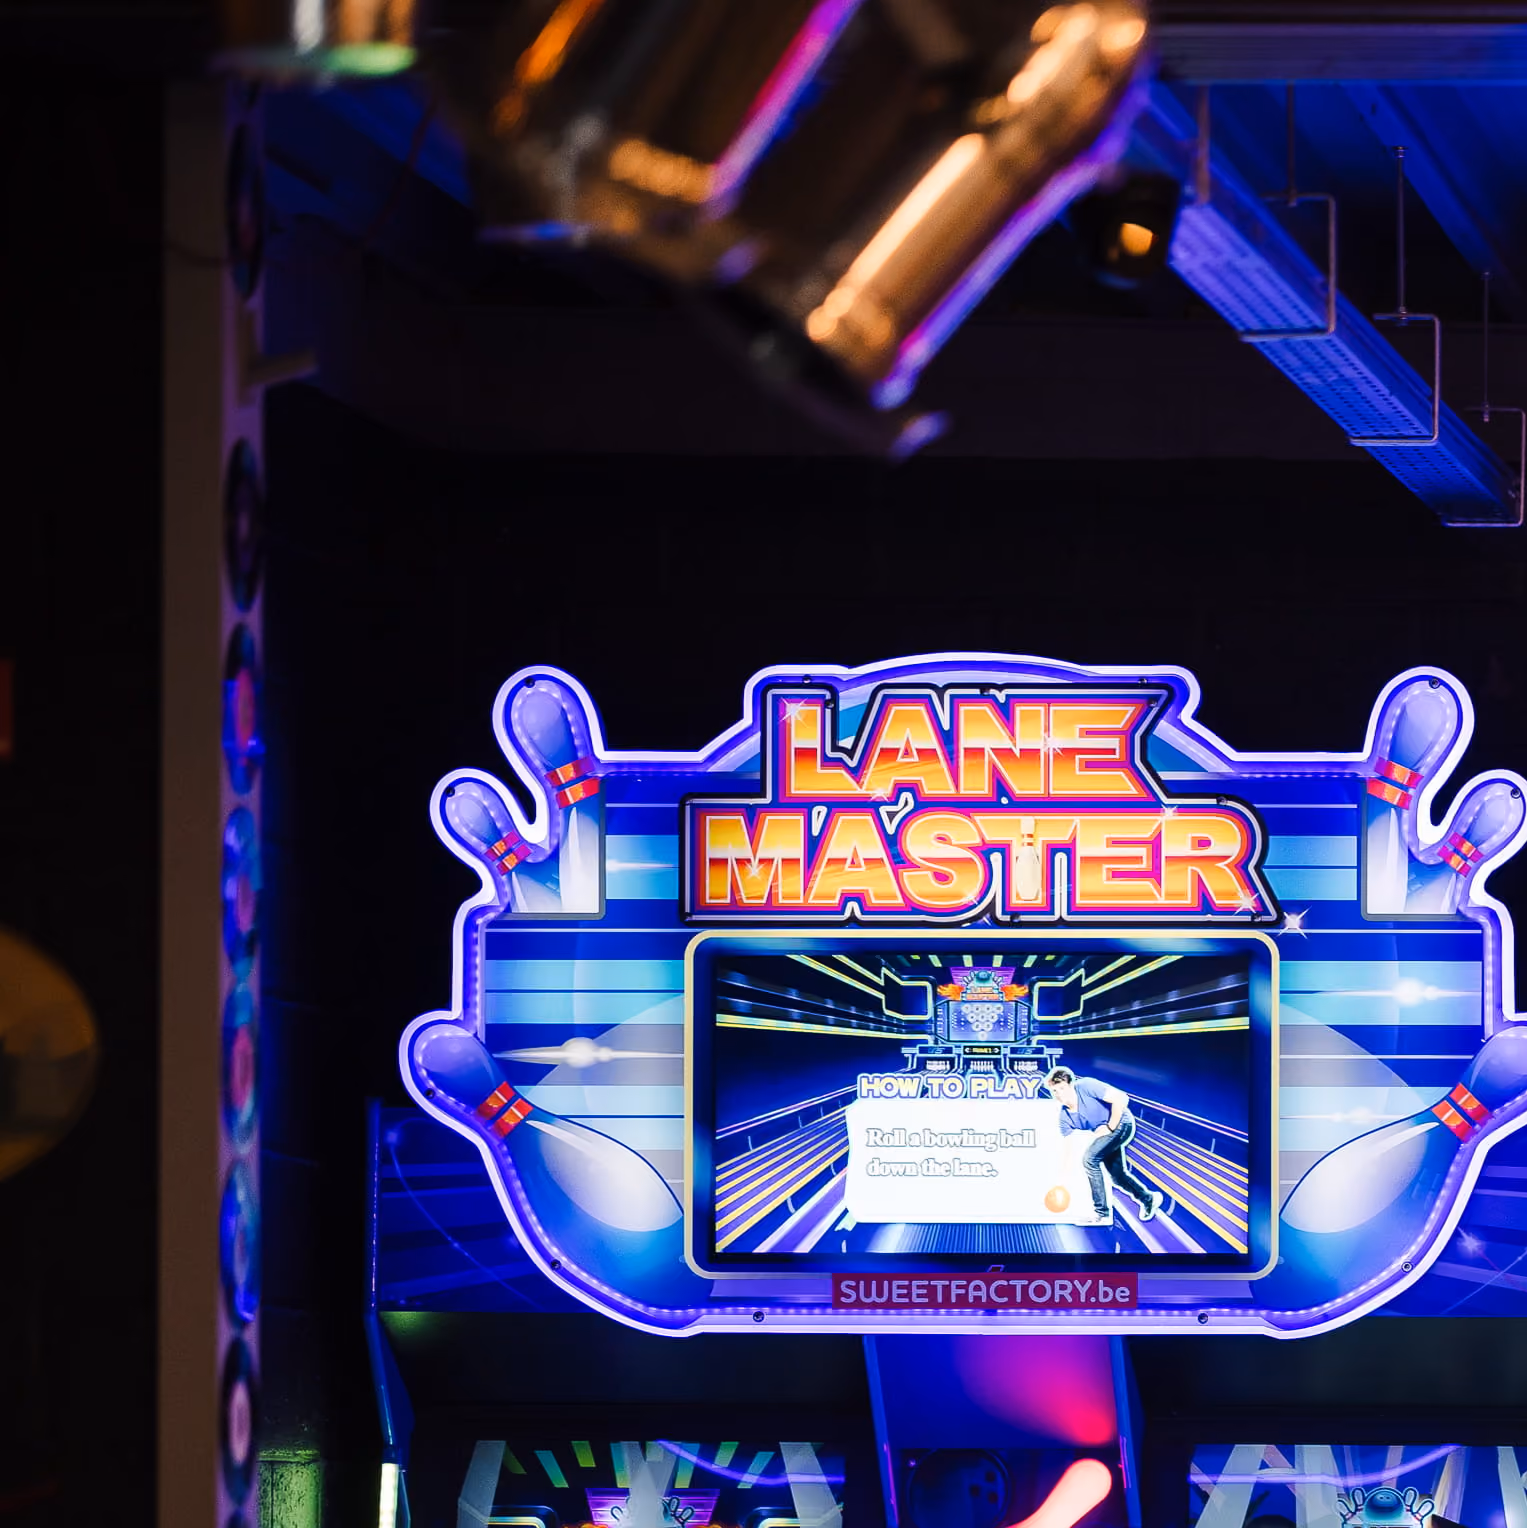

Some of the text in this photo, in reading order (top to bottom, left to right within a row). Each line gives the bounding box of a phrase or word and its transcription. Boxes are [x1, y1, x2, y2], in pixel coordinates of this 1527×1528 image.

[785, 700, 1150, 797] LANE
[700, 808, 1259, 910] MASTER
[859, 1075, 1043, 1099] HOW TO PLAY
[866, 1128, 1036, 1152] Roll a bowling ball
[867, 1158, 998, 1177] down the lane.
[840, 1279, 1131, 1303] SWEETFACTORY.be
